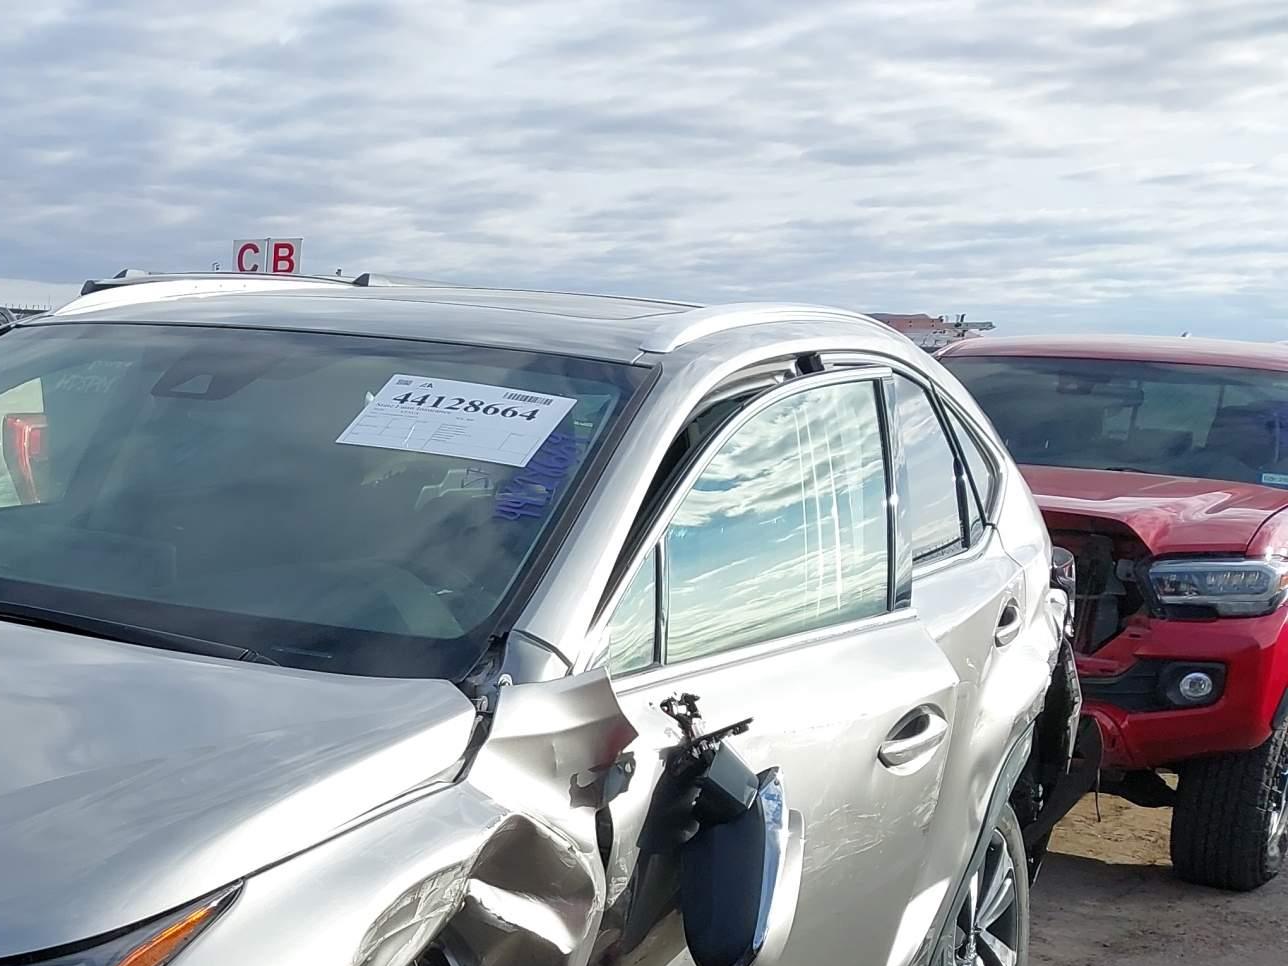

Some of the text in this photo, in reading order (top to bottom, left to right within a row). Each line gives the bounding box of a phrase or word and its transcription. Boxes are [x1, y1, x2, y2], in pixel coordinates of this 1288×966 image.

[237, 242, 295, 273] C B
[392, 391, 540, 422] 44128664
